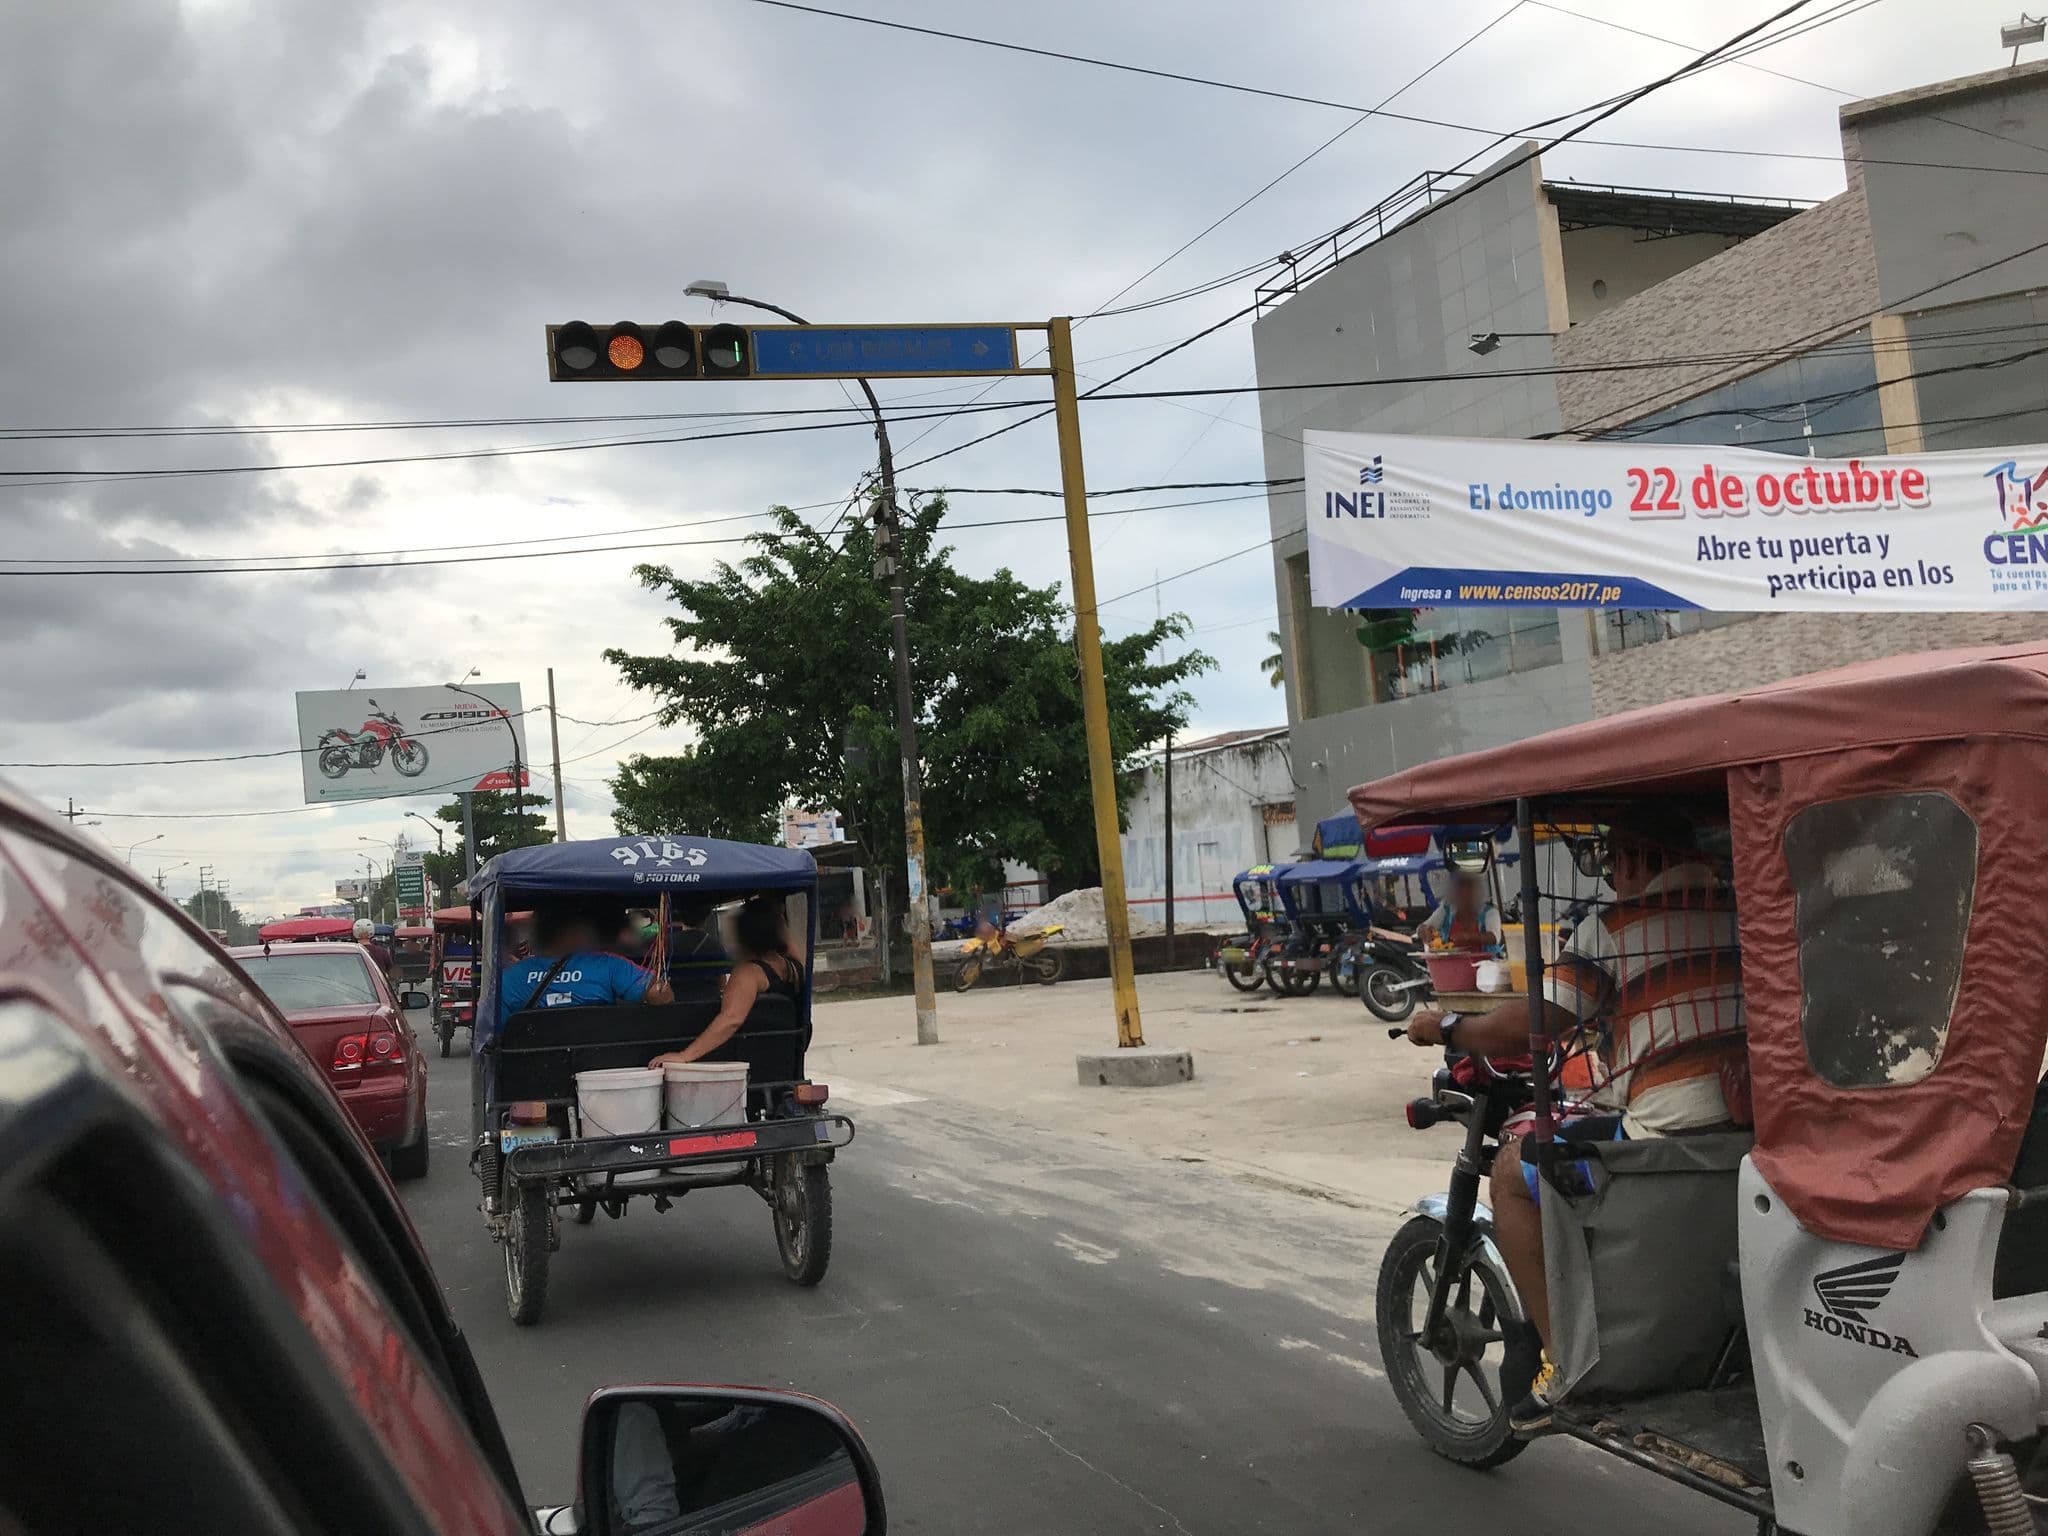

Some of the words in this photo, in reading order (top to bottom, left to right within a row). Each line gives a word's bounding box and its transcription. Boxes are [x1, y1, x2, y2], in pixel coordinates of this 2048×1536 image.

[1468, 484, 1491, 510] El
[1498, 483, 1612, 517] domingo
[1626, 466, 1682, 513] 22
[1691, 463, 1745, 511] de
[1755, 460, 1926, 507] octubre
[1326, 491, 1385, 519] INEI
[1696, 534, 1751, 561] Abre
[1756, 535, 1783, 559] tu
[1789, 531, 1872, 564] puerta
[1876, 533, 1891, 559] y
[1767, 563, 1877, 598] participa
[1883, 567, 1914, 588] en
[1917, 559, 1955, 585] los
[1992, 582, 2018, 592] para
[2021, 580, 2031, 590] el
[1400, 586, 1442, 602] Ingresa
[1443, 588, 1452, 599] a
[1459, 583, 1622, 605] www.censos2017.pe
[454, 703, 478, 711] NUEVA
[609, 842, 709, 867] 9165
[646, 872, 701, 882] MOTOKAR
[1803, 1307, 1919, 1359] HONDA
